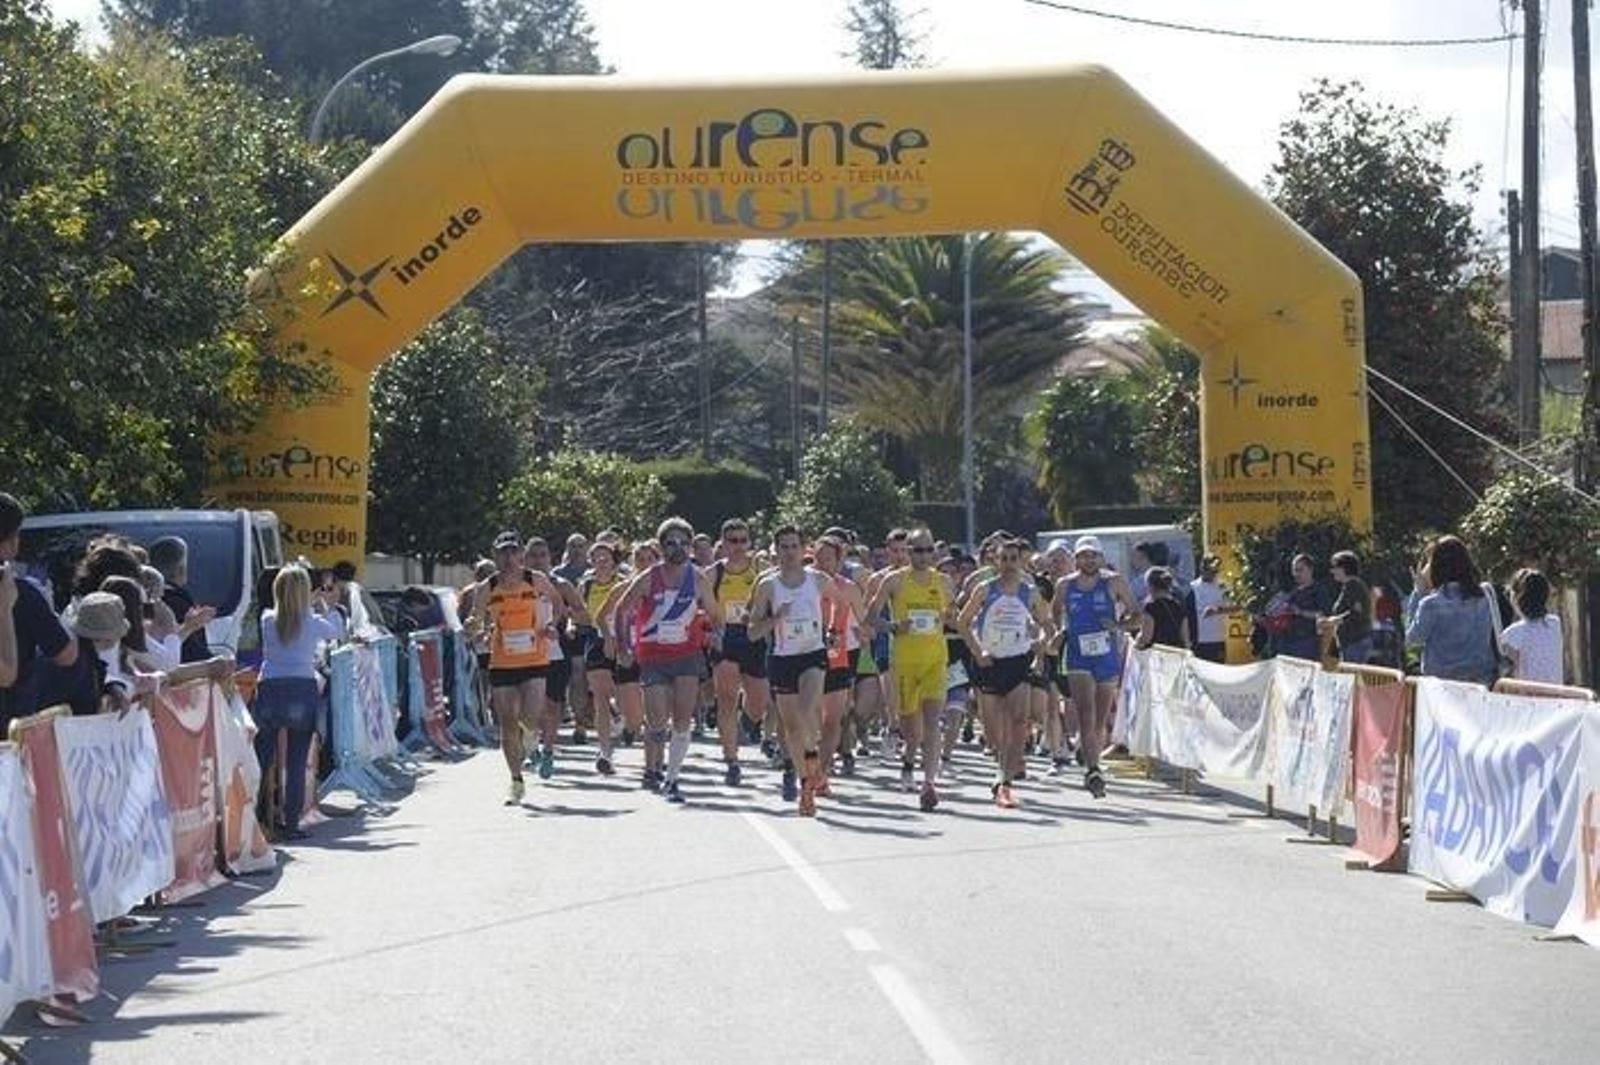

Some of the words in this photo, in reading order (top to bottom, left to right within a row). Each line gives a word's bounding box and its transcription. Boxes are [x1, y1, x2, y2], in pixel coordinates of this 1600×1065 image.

[616, 108, 930, 170] ourense
[621, 171, 711, 186] DESTINO
[720, 170, 825, 186] TURISTICO
[848, 169, 926, 184] TERMAL
[391, 206, 482, 286] inorde
[1256, 391, 1320, 408] inorde
